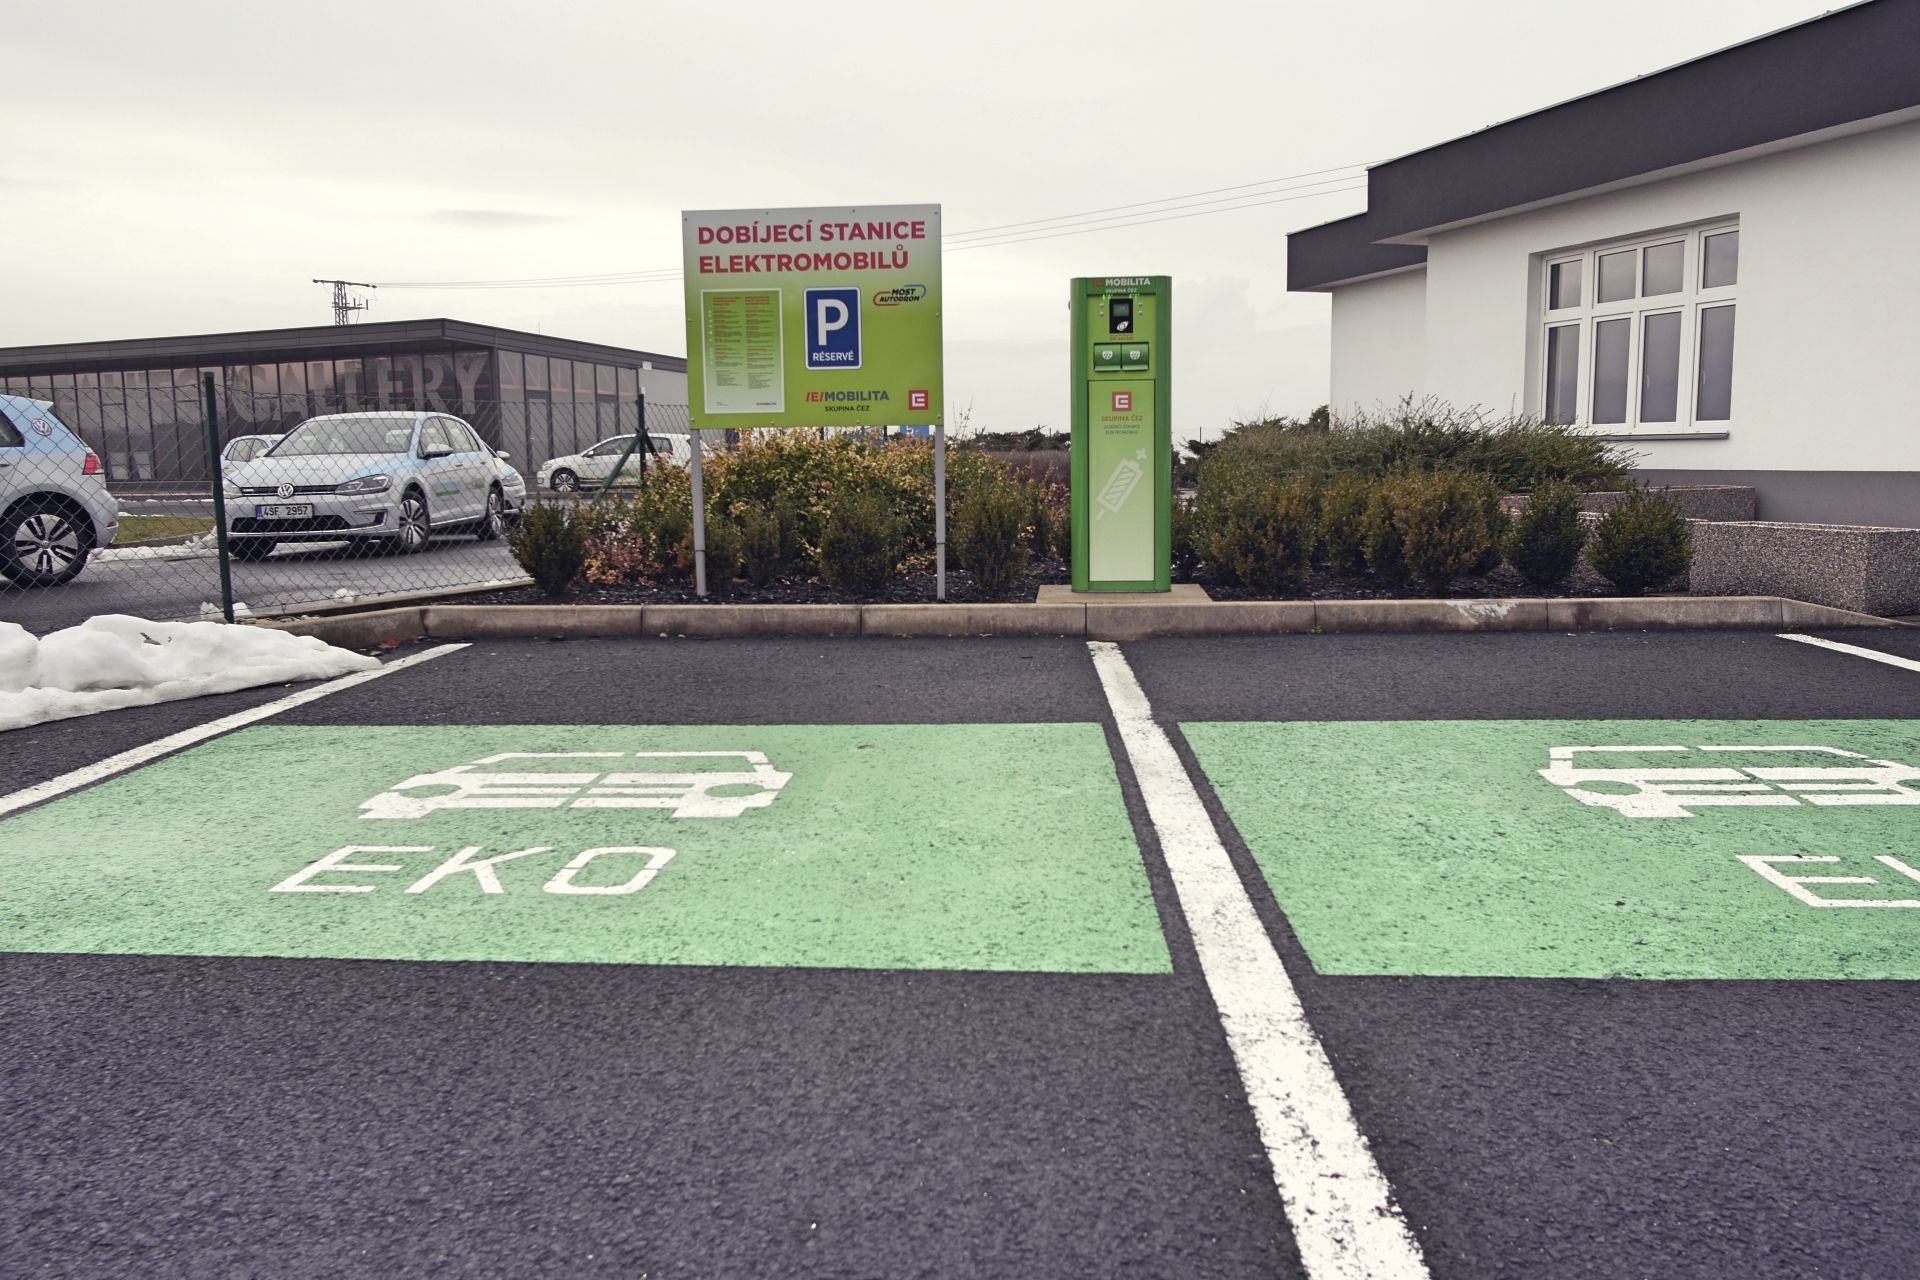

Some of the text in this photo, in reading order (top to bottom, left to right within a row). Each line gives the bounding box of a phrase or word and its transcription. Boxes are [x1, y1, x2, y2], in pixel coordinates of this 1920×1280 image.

[698, 219, 927, 245] DOBÍJECÍ STANICE
[699, 244, 909, 273] ELEKTROMOBILŮ
[892, 288, 916, 296] MOST
[817, 299, 849, 345] P
[813, 350, 854, 362] RÉSERVÉ
[232, 351, 490, 423] GALLERY
[856, 404, 871, 412] ČEZ
[264, 505, 308, 516] 4SF 2957
[268, 845, 676, 894] EKO
